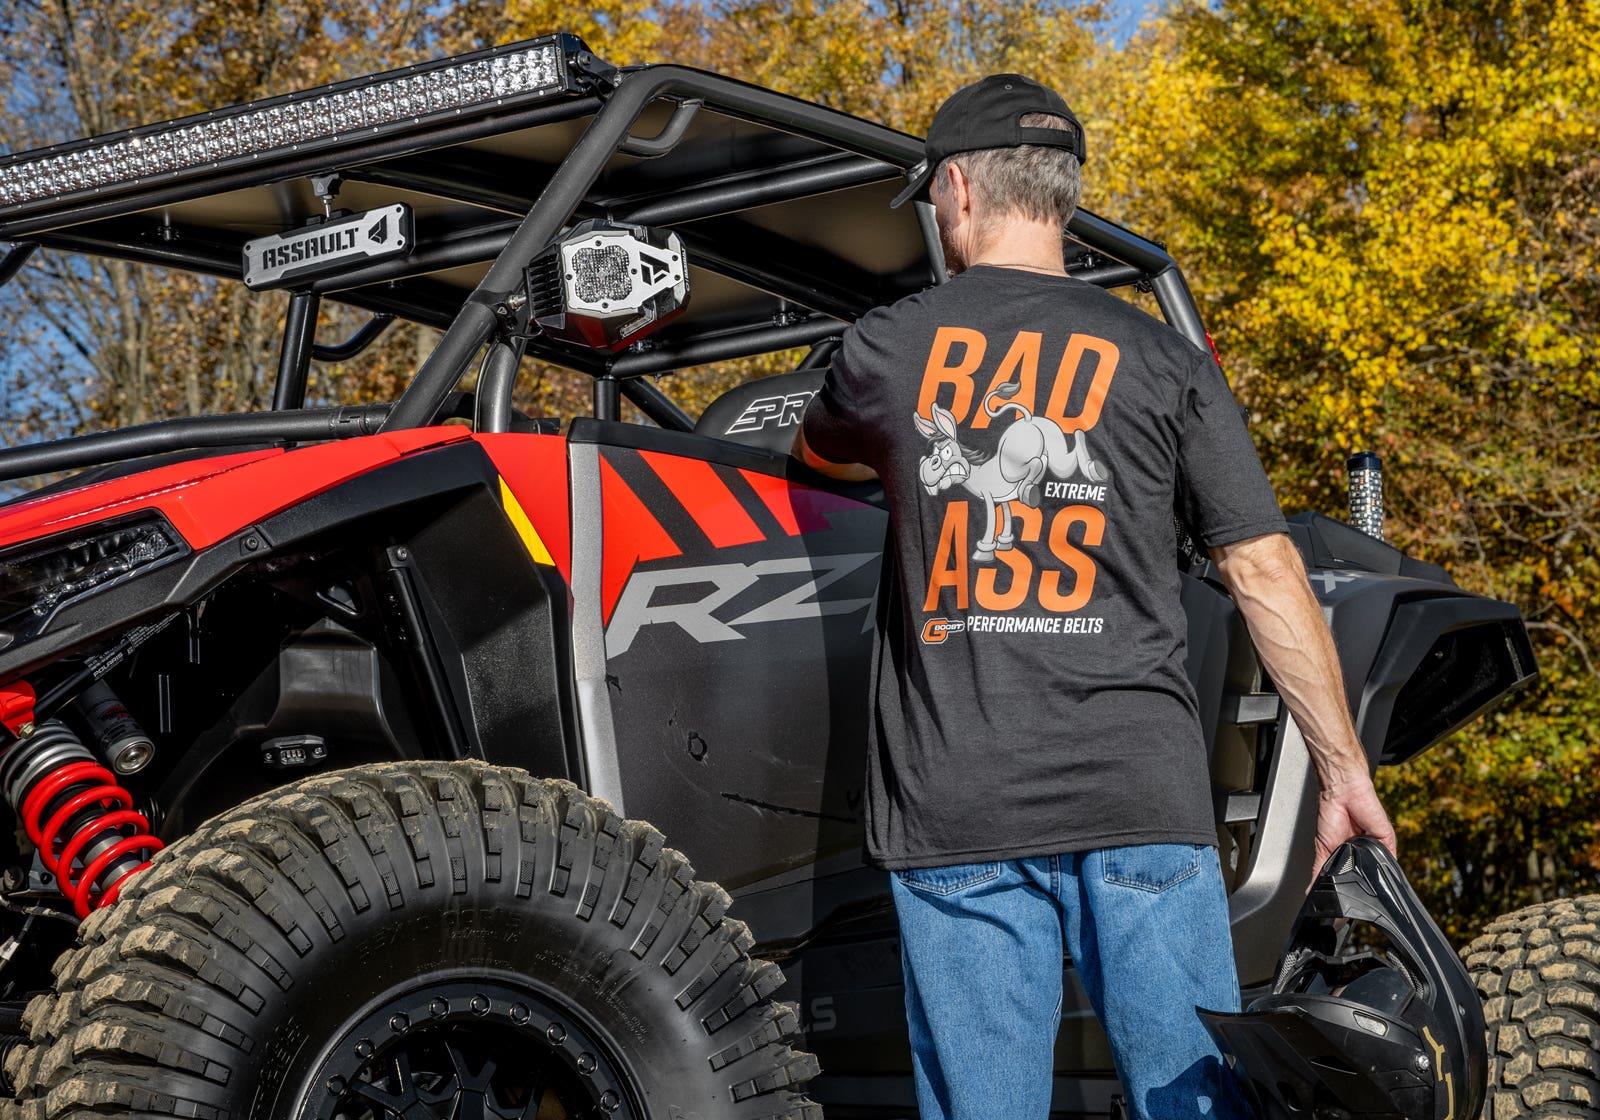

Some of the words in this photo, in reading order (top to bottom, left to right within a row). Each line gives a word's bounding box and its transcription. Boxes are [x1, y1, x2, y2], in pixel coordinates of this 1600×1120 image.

[262, 227, 359, 270] ASSAULT
[917, 326, 1120, 434] BAD
[724, 390, 820, 435] PR
[1044, 481, 1107, 501] EXTREME
[922, 500, 1106, 612] ASS
[604, 552, 882, 661] RZ
[967, 615, 1060, 634] PERFORMANCE
[1063, 617, 1104, 634] BELTS
